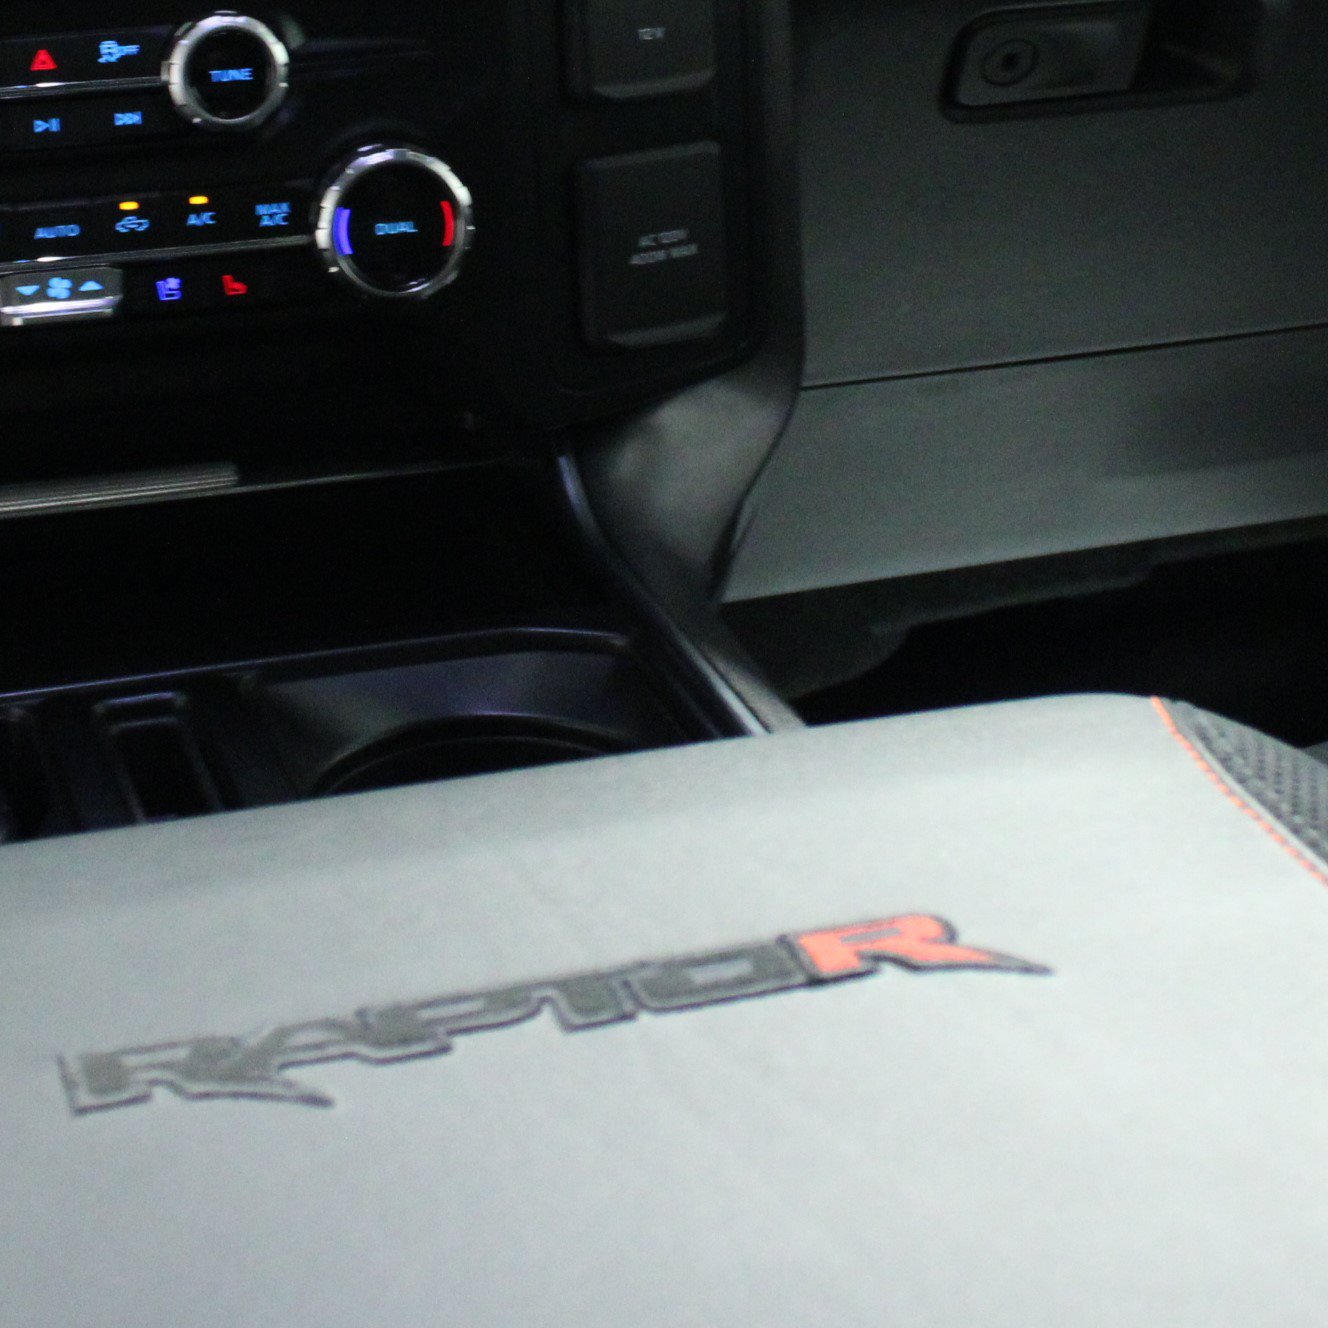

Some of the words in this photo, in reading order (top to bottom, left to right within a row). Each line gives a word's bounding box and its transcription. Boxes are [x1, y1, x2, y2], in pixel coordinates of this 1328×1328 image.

[34, 224, 81, 239] AUTO
[374, 221, 419, 236] DUAL
[58, 913, 1053, 1115] RAPTOR
